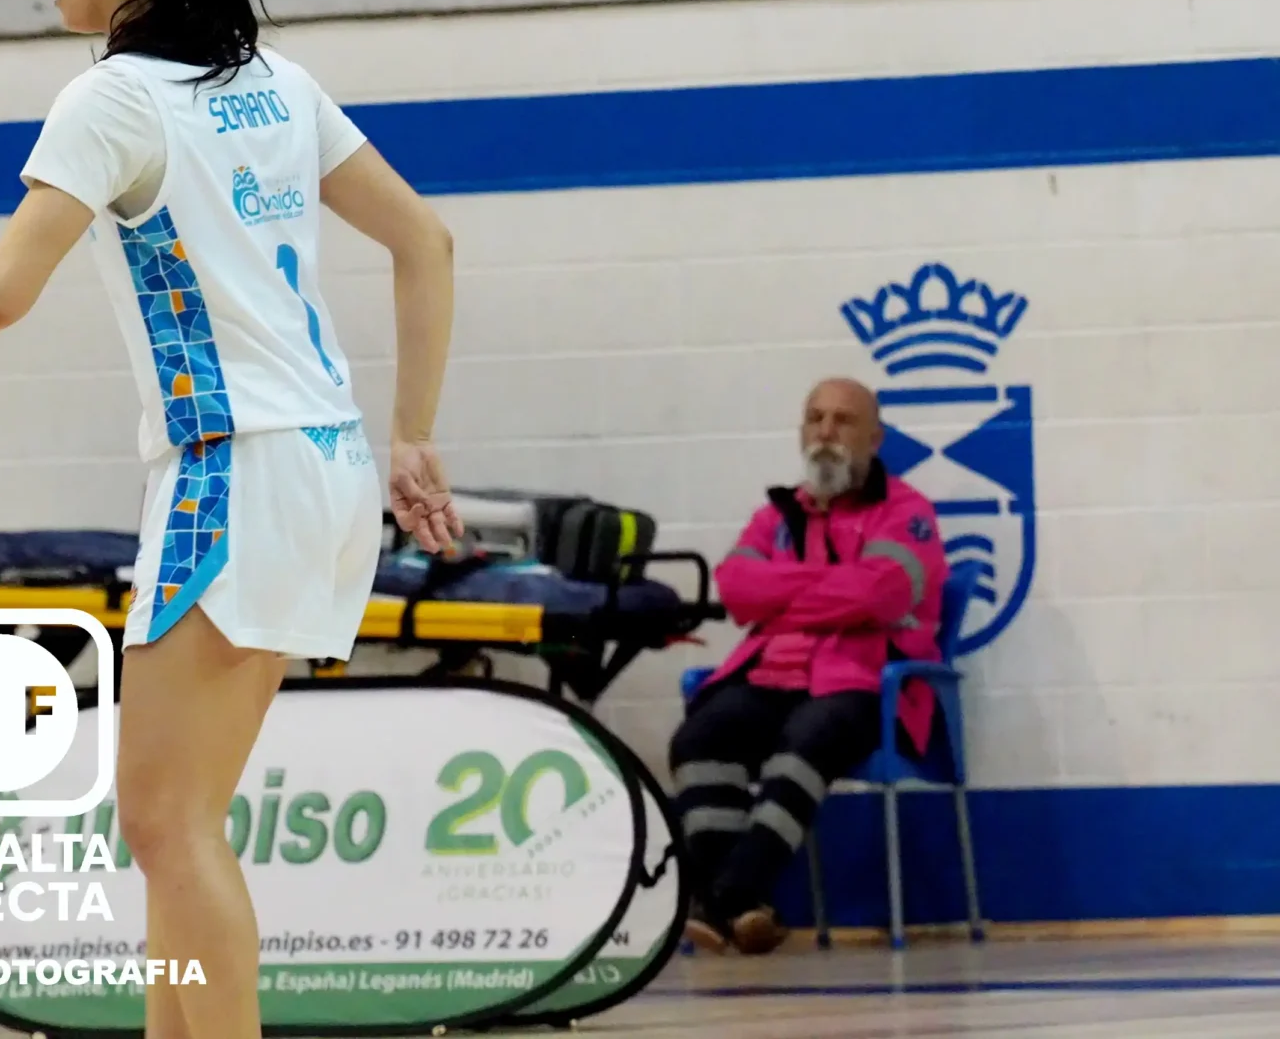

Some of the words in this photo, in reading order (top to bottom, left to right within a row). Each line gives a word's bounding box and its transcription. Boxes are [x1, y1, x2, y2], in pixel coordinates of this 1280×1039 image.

[208, 89, 290, 134] SORIANO
[424, 748, 592, 856] 20
[395, 928, 422, 950] 91
[431, 928, 476, 950] 498
[483, 928, 512, 949] 72
[518, 927, 548, 949] 26
[359, 969, 443, 994] Leganés
[447, 968, 535, 992] (Madrid)
